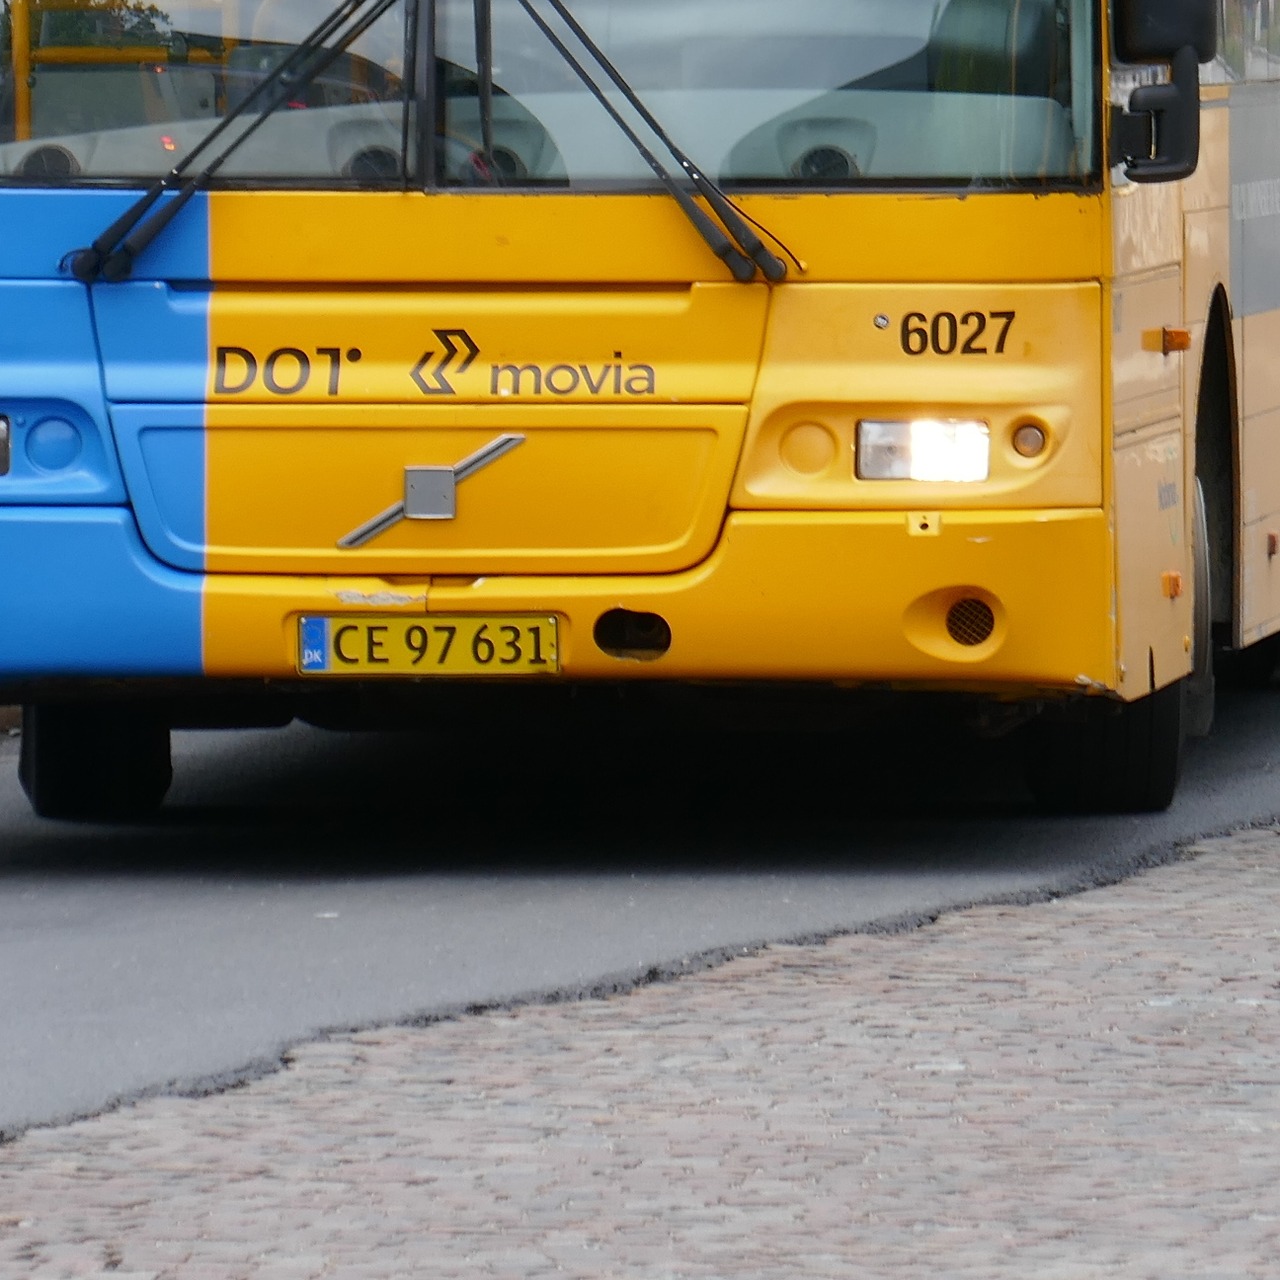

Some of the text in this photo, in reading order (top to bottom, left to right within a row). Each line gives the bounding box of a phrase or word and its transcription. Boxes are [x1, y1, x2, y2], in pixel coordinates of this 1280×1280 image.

[901, 311, 1016, 355] 6027
[214, 346, 361, 396] DOT
[490, 351, 655, 396] movia
[304, 649, 322, 664] DK
[334, 624, 547, 665] CE 97 631
